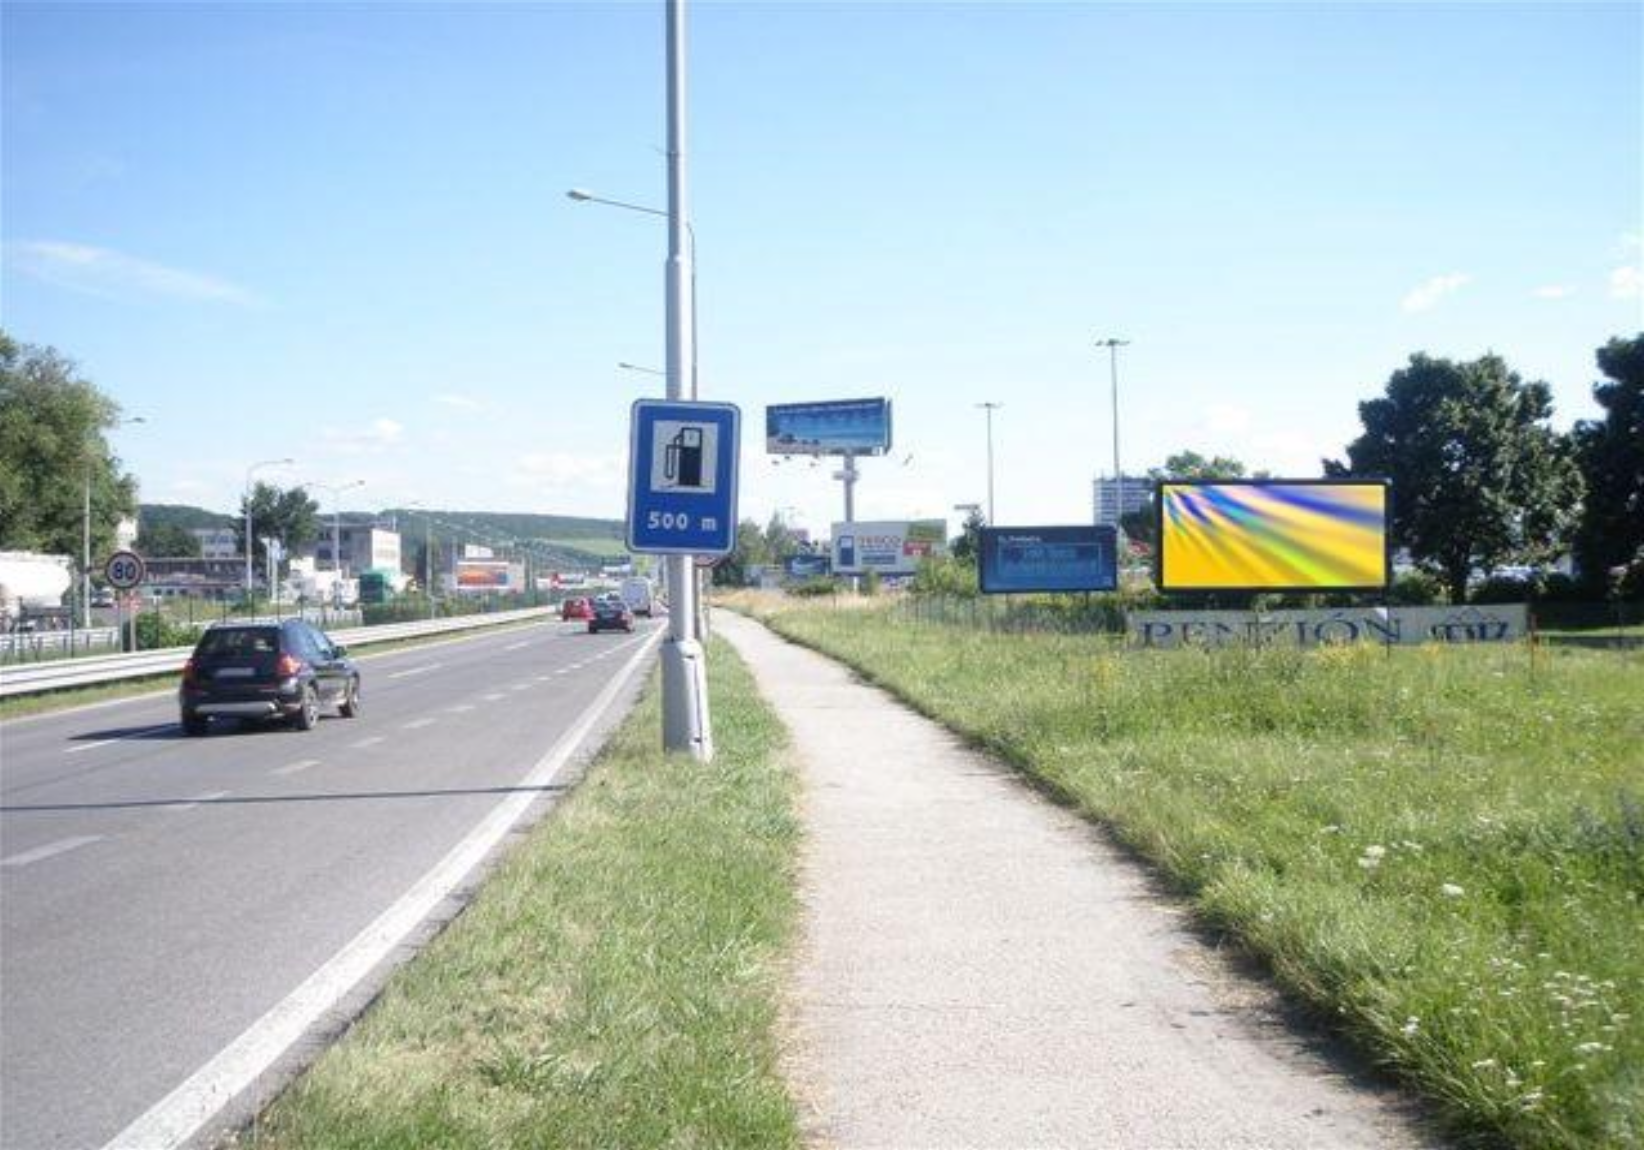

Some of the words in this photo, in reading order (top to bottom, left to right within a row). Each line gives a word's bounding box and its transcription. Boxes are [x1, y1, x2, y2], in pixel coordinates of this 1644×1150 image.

[646, 510, 689, 530] 500
[701, 517, 717, 532] m
[112, 561, 137, 580] 80
